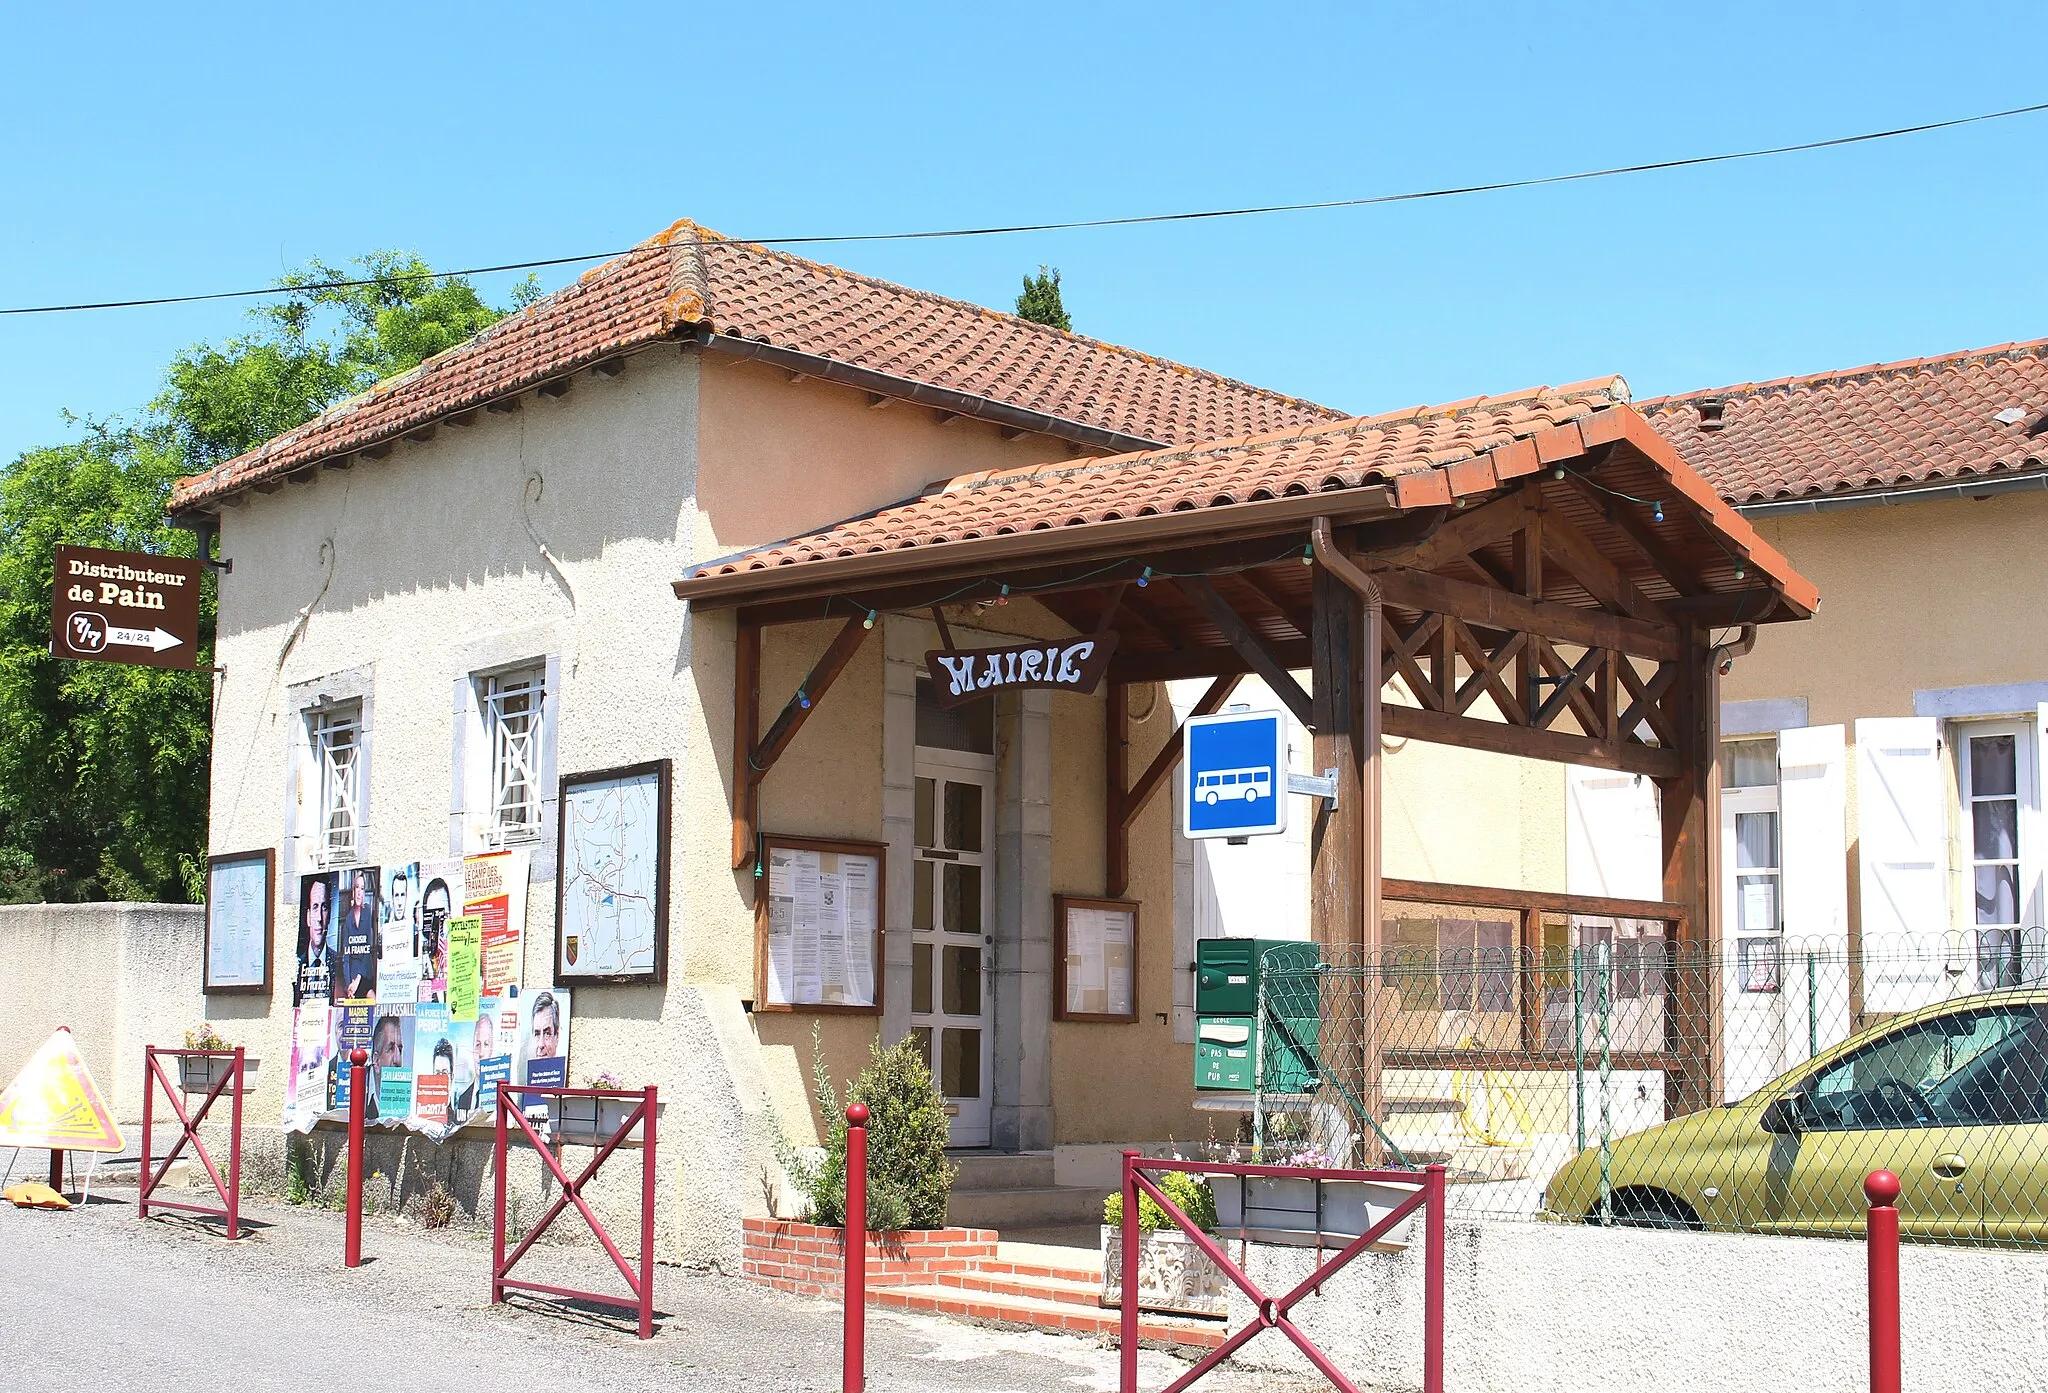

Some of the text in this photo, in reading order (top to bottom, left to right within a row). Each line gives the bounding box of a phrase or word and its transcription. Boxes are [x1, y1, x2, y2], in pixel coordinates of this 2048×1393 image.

[69, 560, 186, 586] Distributeur
[68, 582, 165, 609] de Pain
[74, 617, 102, 647] 7/7
[117, 631, 150, 642] 24/24
[938, 641, 1094, 695] MAIRIE
[465, 865, 498, 881] LE CAMP DES
[465, 876, 502, 892] TRAVAILLEURS
[348, 935, 367, 944] CHOISIR
[344, 945, 371, 954] LA FRANCE
[300, 979, 306, 991] la
[348, 1007, 369, 1017] MARINE
[373, 1004, 389, 1017] JEAN
[1210, 1049, 1222, 1058] PAS
[1207, 1072, 1221, 1081] PUB
